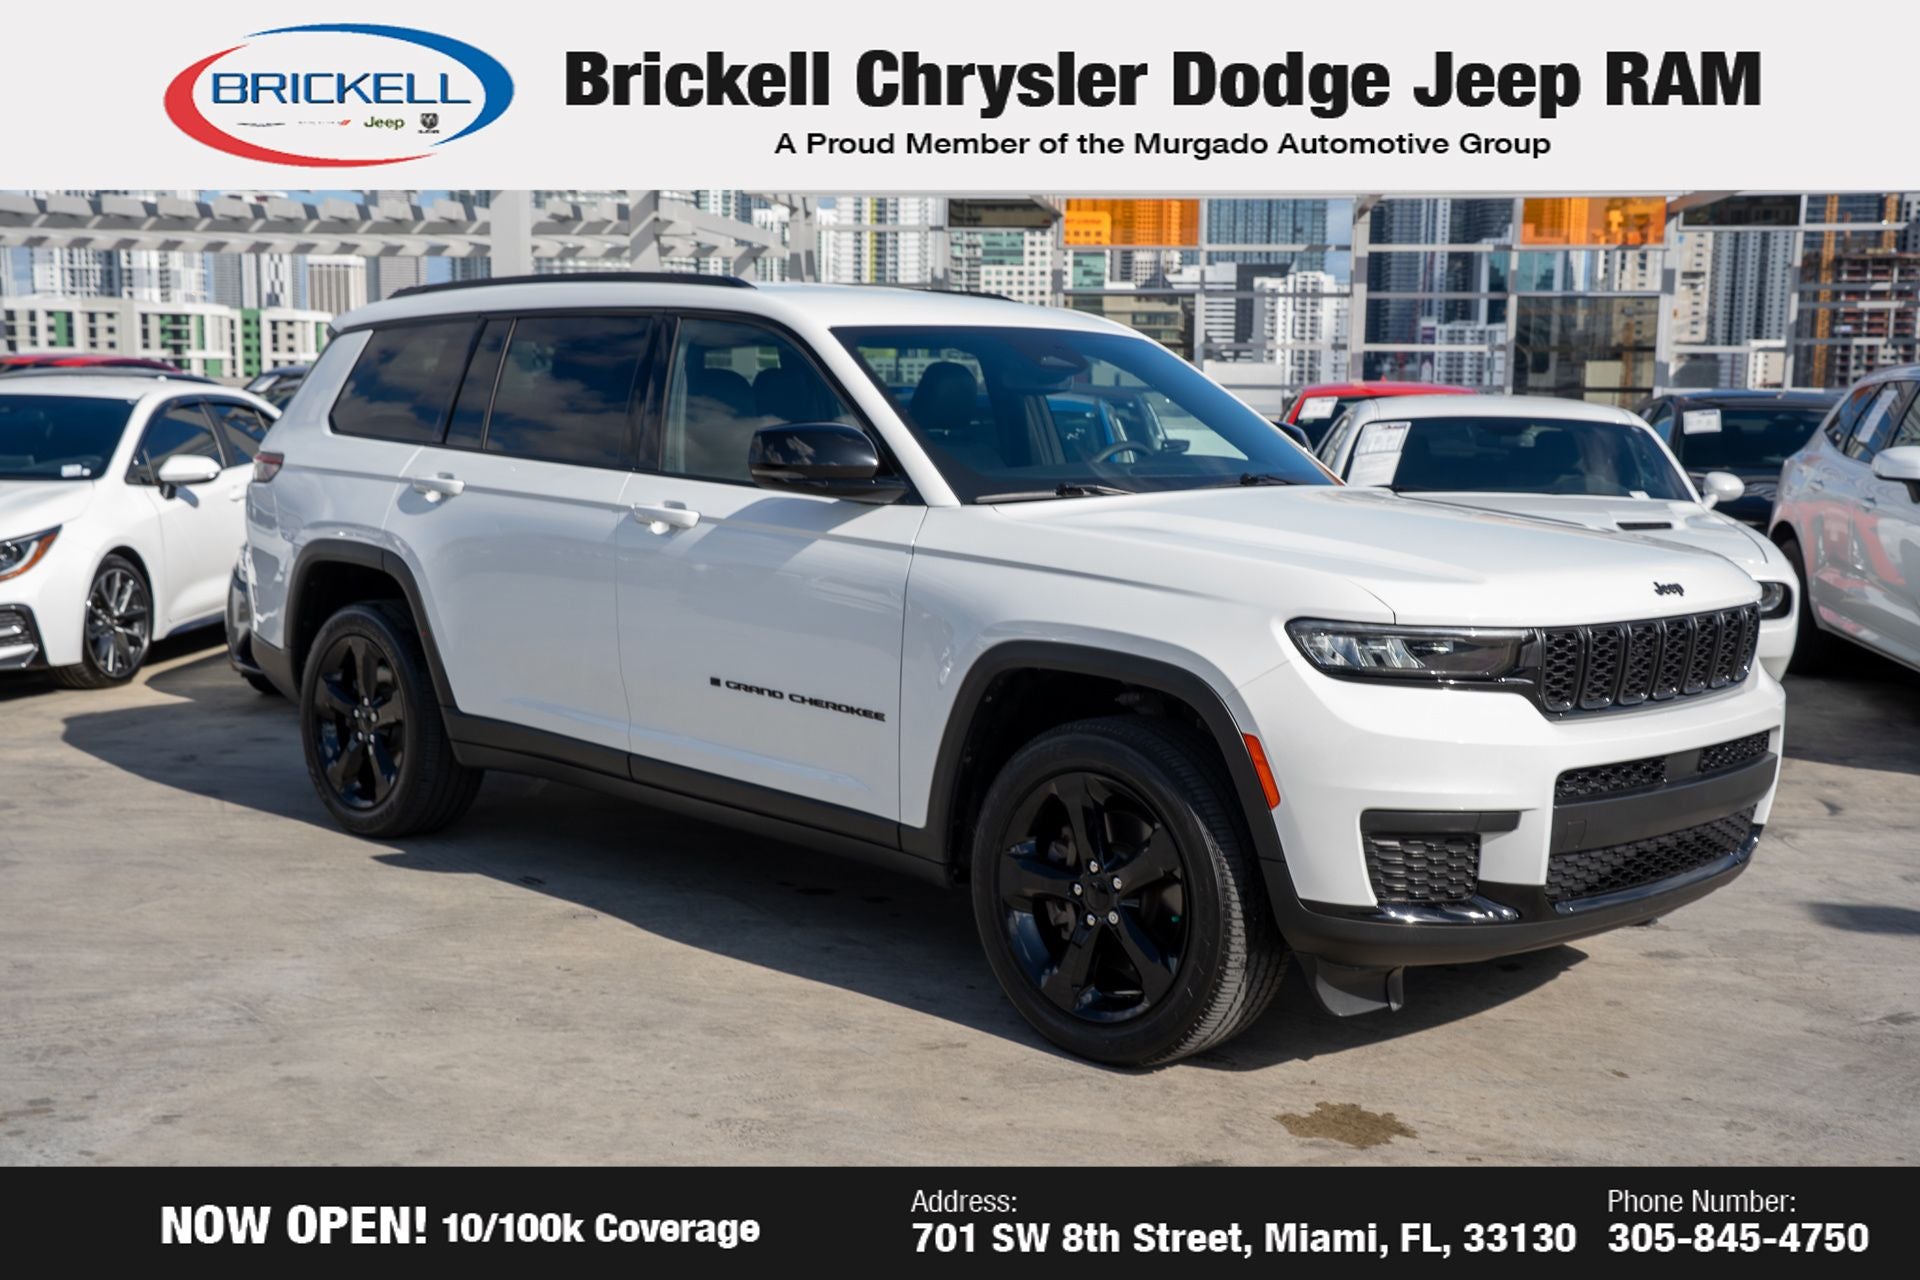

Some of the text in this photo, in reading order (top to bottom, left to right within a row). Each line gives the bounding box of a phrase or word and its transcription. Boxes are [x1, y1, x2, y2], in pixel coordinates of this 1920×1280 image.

[1653, 581, 1685, 597] Jeep
[725, 680, 886, 722] GRAND CHEROKEE
